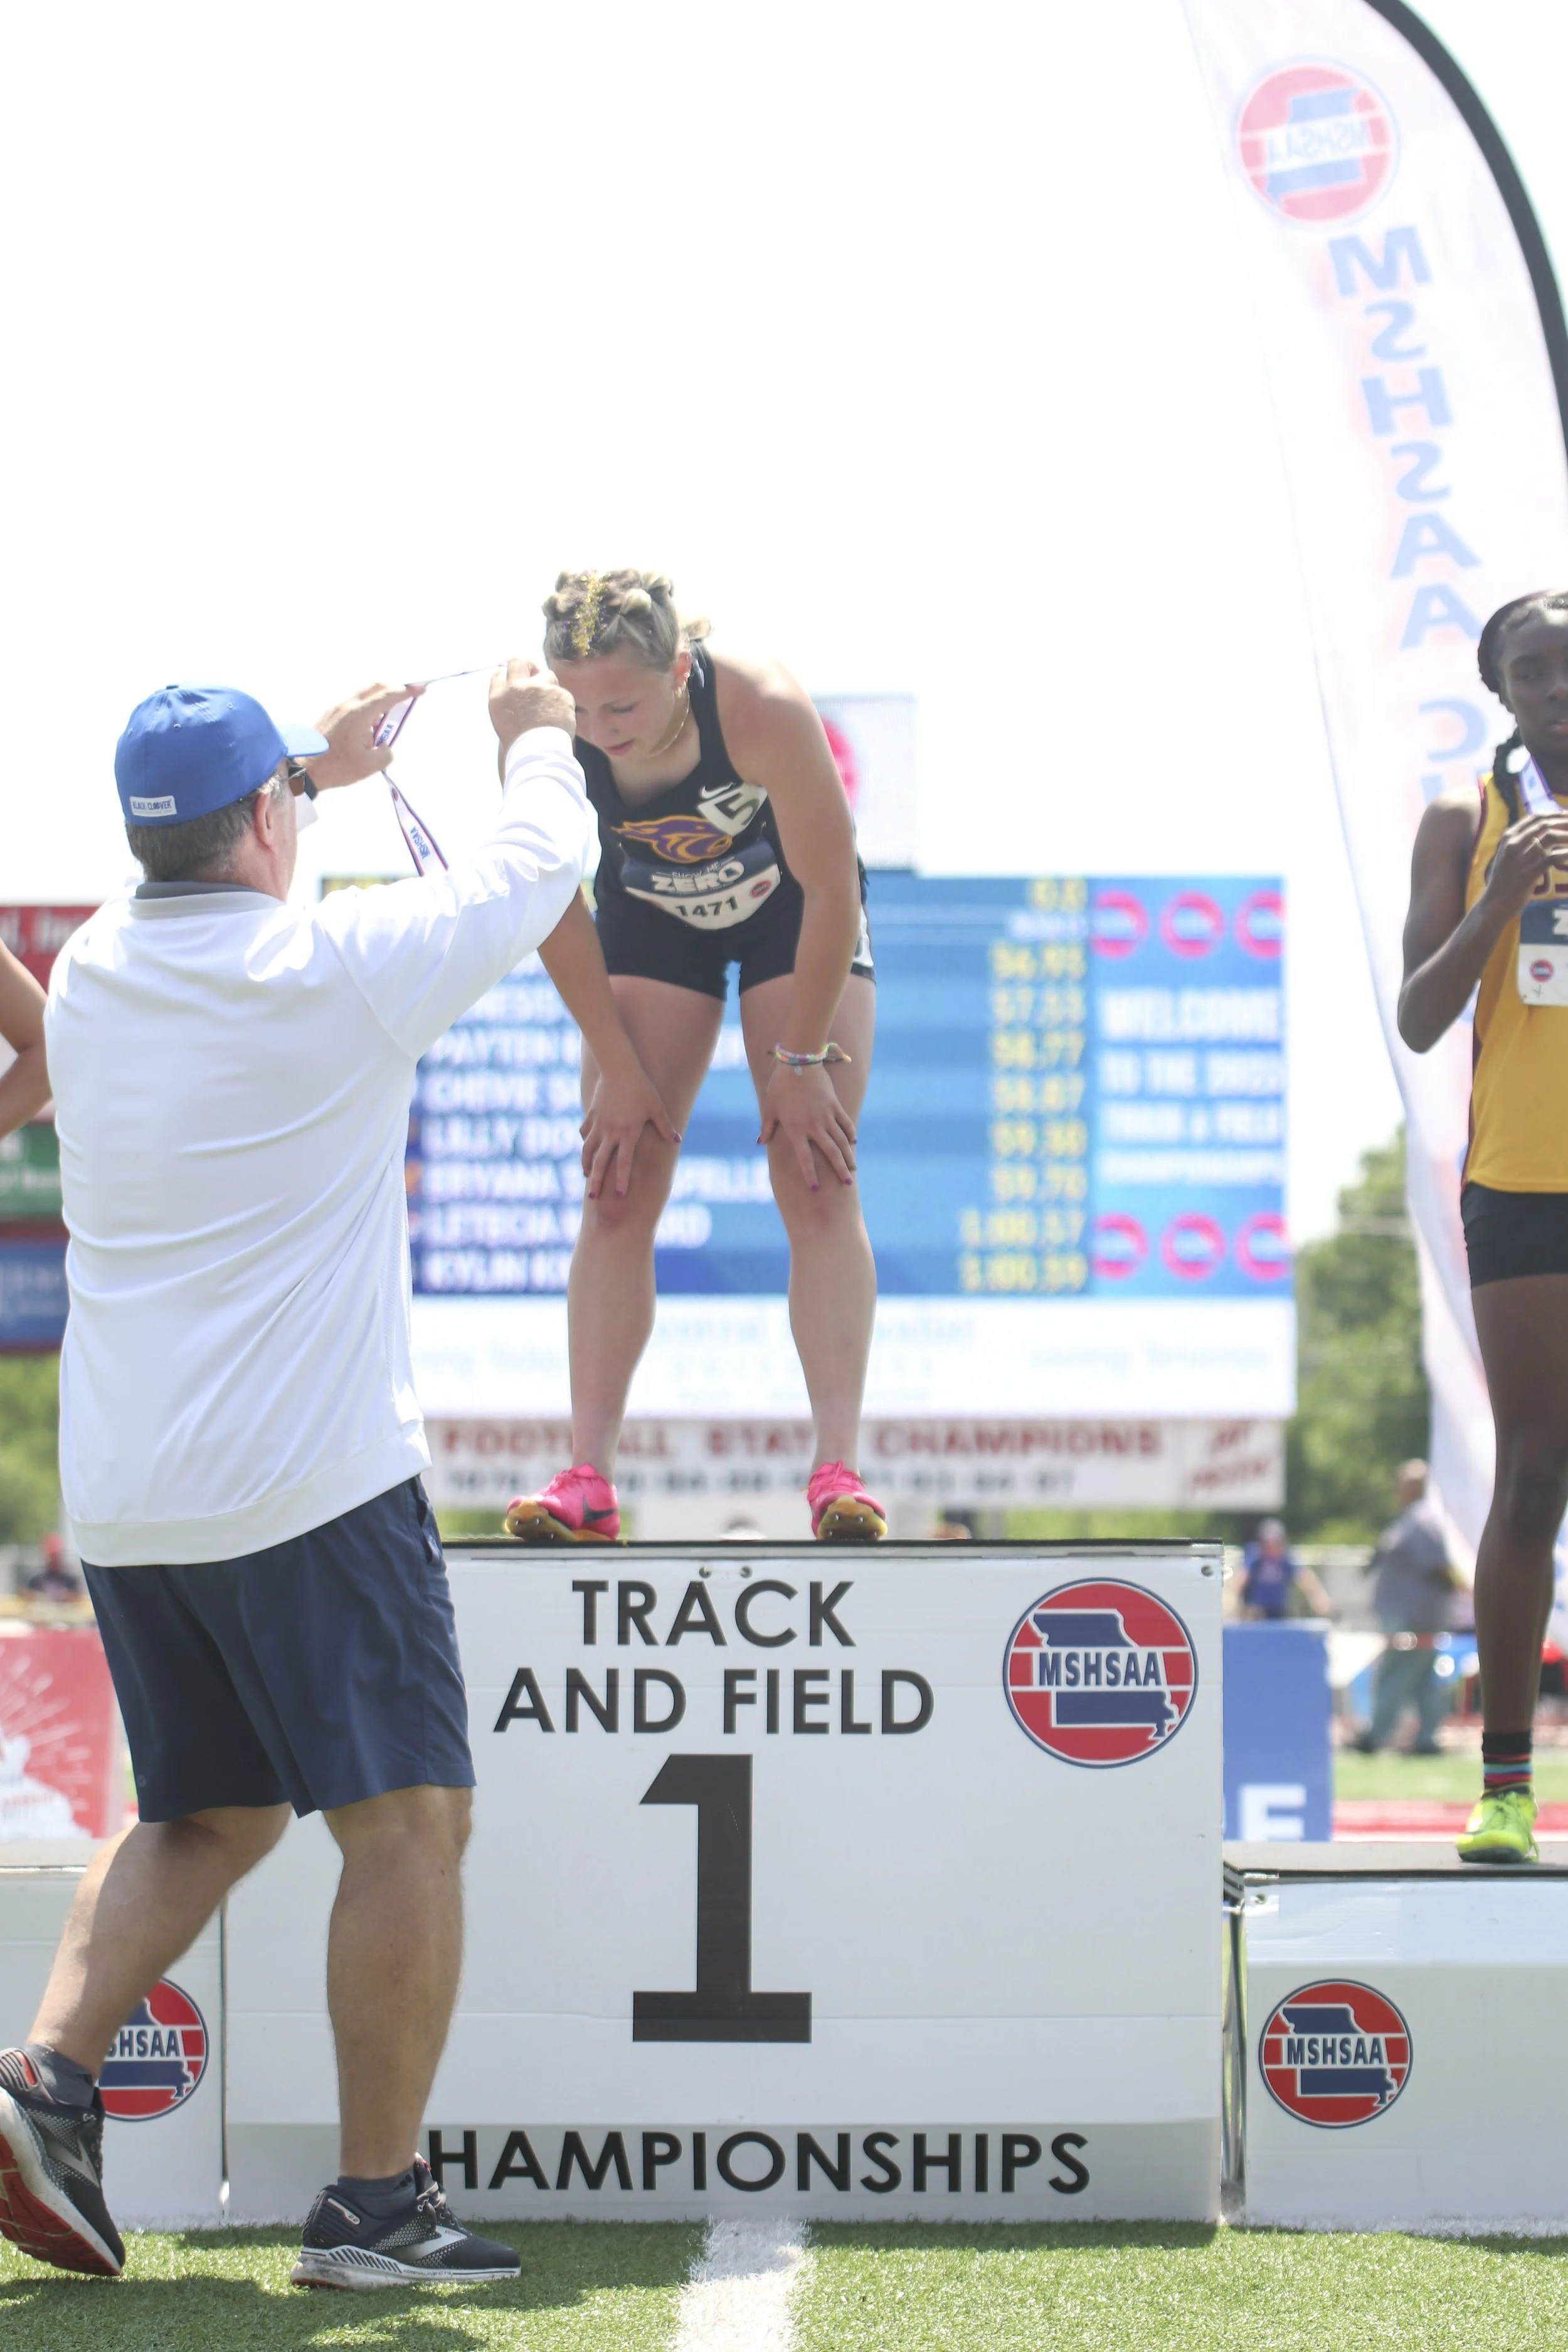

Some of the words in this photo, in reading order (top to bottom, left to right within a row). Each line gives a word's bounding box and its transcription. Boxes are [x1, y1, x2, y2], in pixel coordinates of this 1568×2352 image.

[652, 861, 744, 894] ZERO
[675, 896, 738, 917] 1471
[443, 1422, 669, 1458] FOOTALL
[876, 1422, 1164, 1459] CHAMPIONS
[571, 1579, 856, 1648] TRACK
[1039, 1650, 1162, 1689] MSHSAA
[493, 1666, 687, 1734] AND
[723, 1668, 934, 1735] FIELD
[632, 1754, 812, 2043] 1
[107, 2029, 181, 2058] HSAA
[1286, 2036, 1385, 2066] MSHSAA
[428, 2130, 1091, 2195] HAMPIONSHIPS
